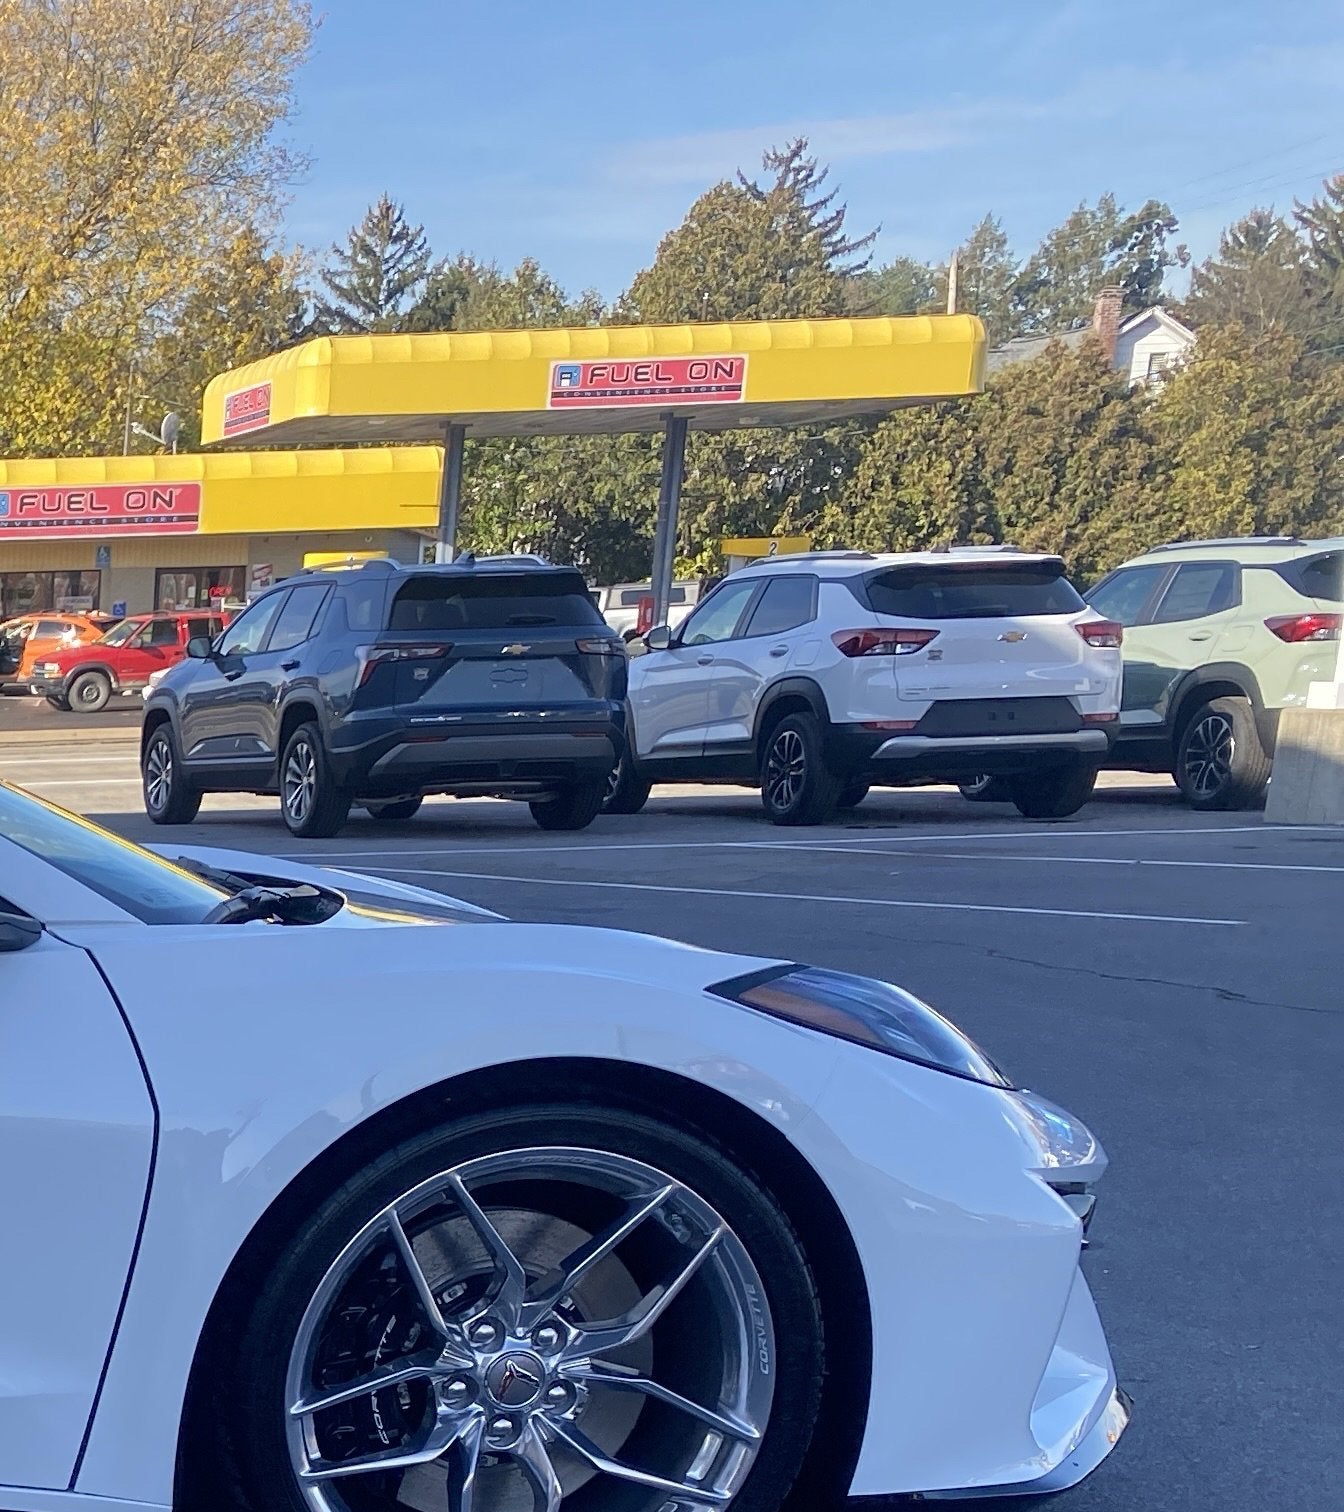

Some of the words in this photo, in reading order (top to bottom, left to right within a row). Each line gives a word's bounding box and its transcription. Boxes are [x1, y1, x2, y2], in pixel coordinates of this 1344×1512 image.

[588, 363, 673, 384] FUEL
[688, 360, 735, 380] ON
[18, 492, 108, 513] FUEL
[125, 488, 175, 510] ON
[769, 541, 777, 556] 2
